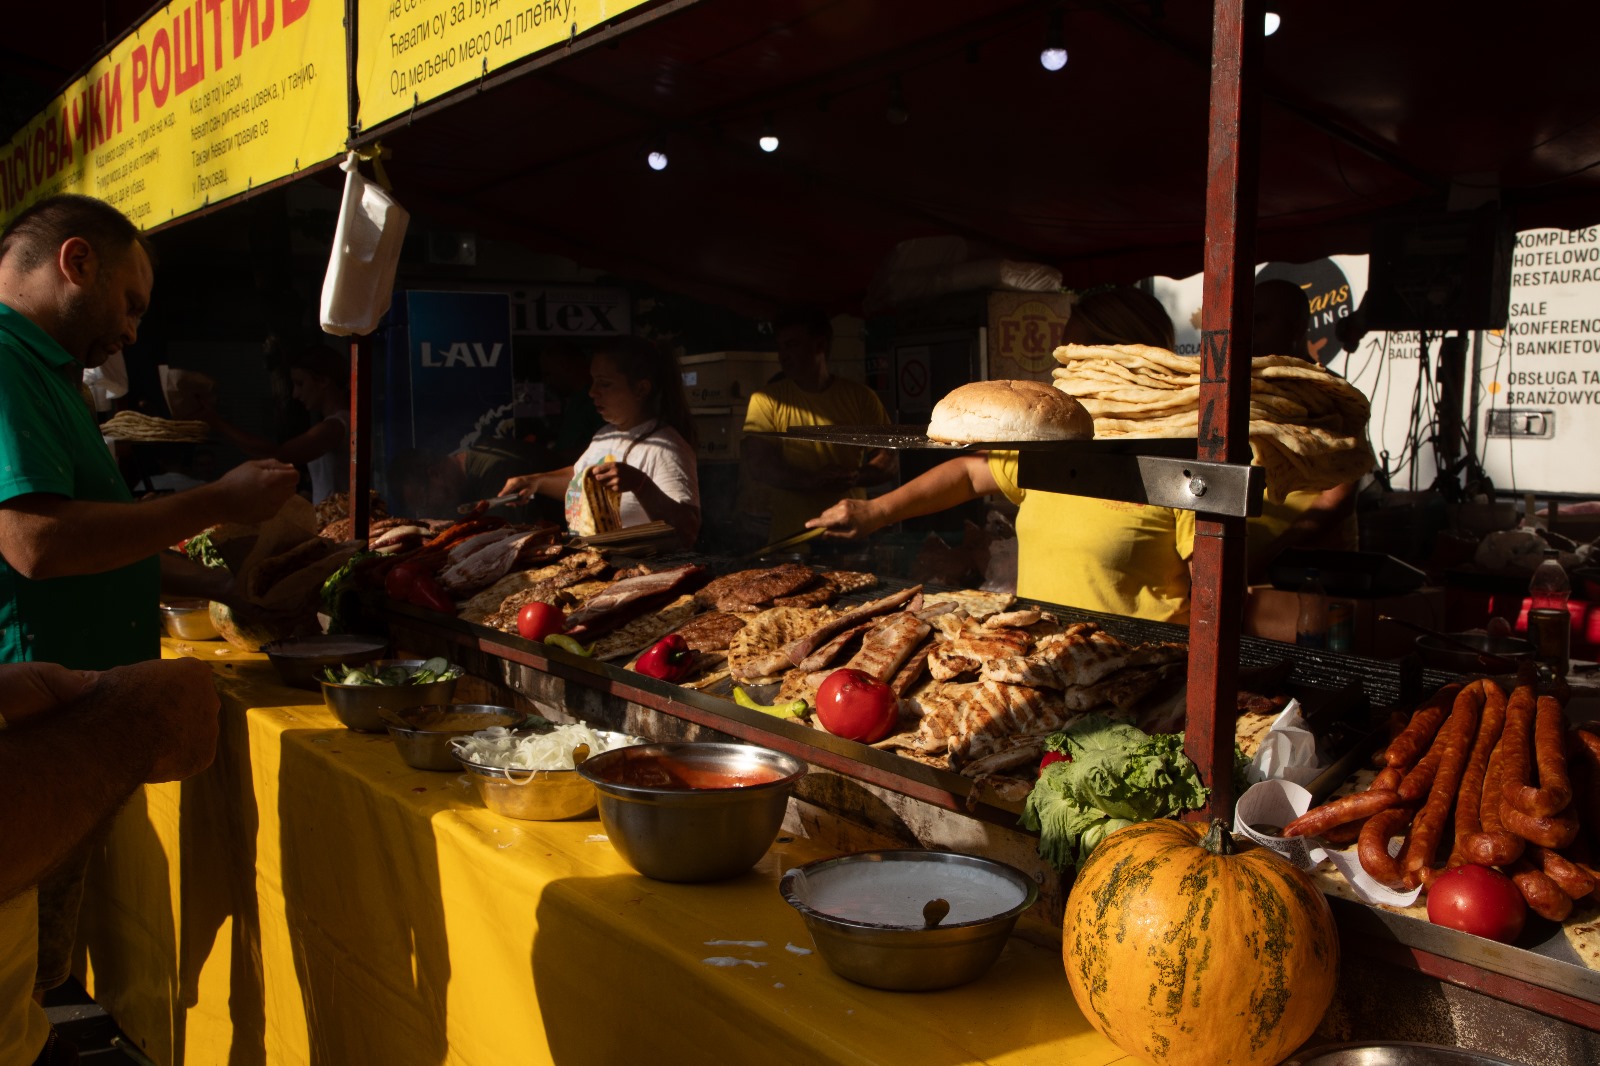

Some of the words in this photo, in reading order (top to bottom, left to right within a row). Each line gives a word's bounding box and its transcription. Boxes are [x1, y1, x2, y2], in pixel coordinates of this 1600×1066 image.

[389, 16, 430, 58] Ћевапи
[432, 10, 447, 40] су
[450, 4, 466, 26] за
[390, 69, 407, 98] Од
[409, 47, 456, 88] мељено
[459, 30, 491, 64] месо
[494, 19, 512, 49] од
[190, 96, 202, 115] Кад
[203, 92, 211, 109] се
[211, 82, 221, 104] тој
[241, 97, 250, 114] на
[281, 78, 287, 100] у
[0, 62, 122, 212] ЛСКОВАЧКИ
[259, 119, 269, 136] се
[192, 180, 197, 200] у
[1515, 228, 1598, 249] KOMPLEKS
[1514, 247, 1600, 268] HOTELOWO
[512, 290, 620, 331] itex
[1300, 283, 1350, 315] ans
[1511, 301, 1548, 317] SALE
[420, 341, 504, 368] LAV
[1507, 370, 1578, 386] OBSŁUGA
[1582, 369, 1600, 385] TA
